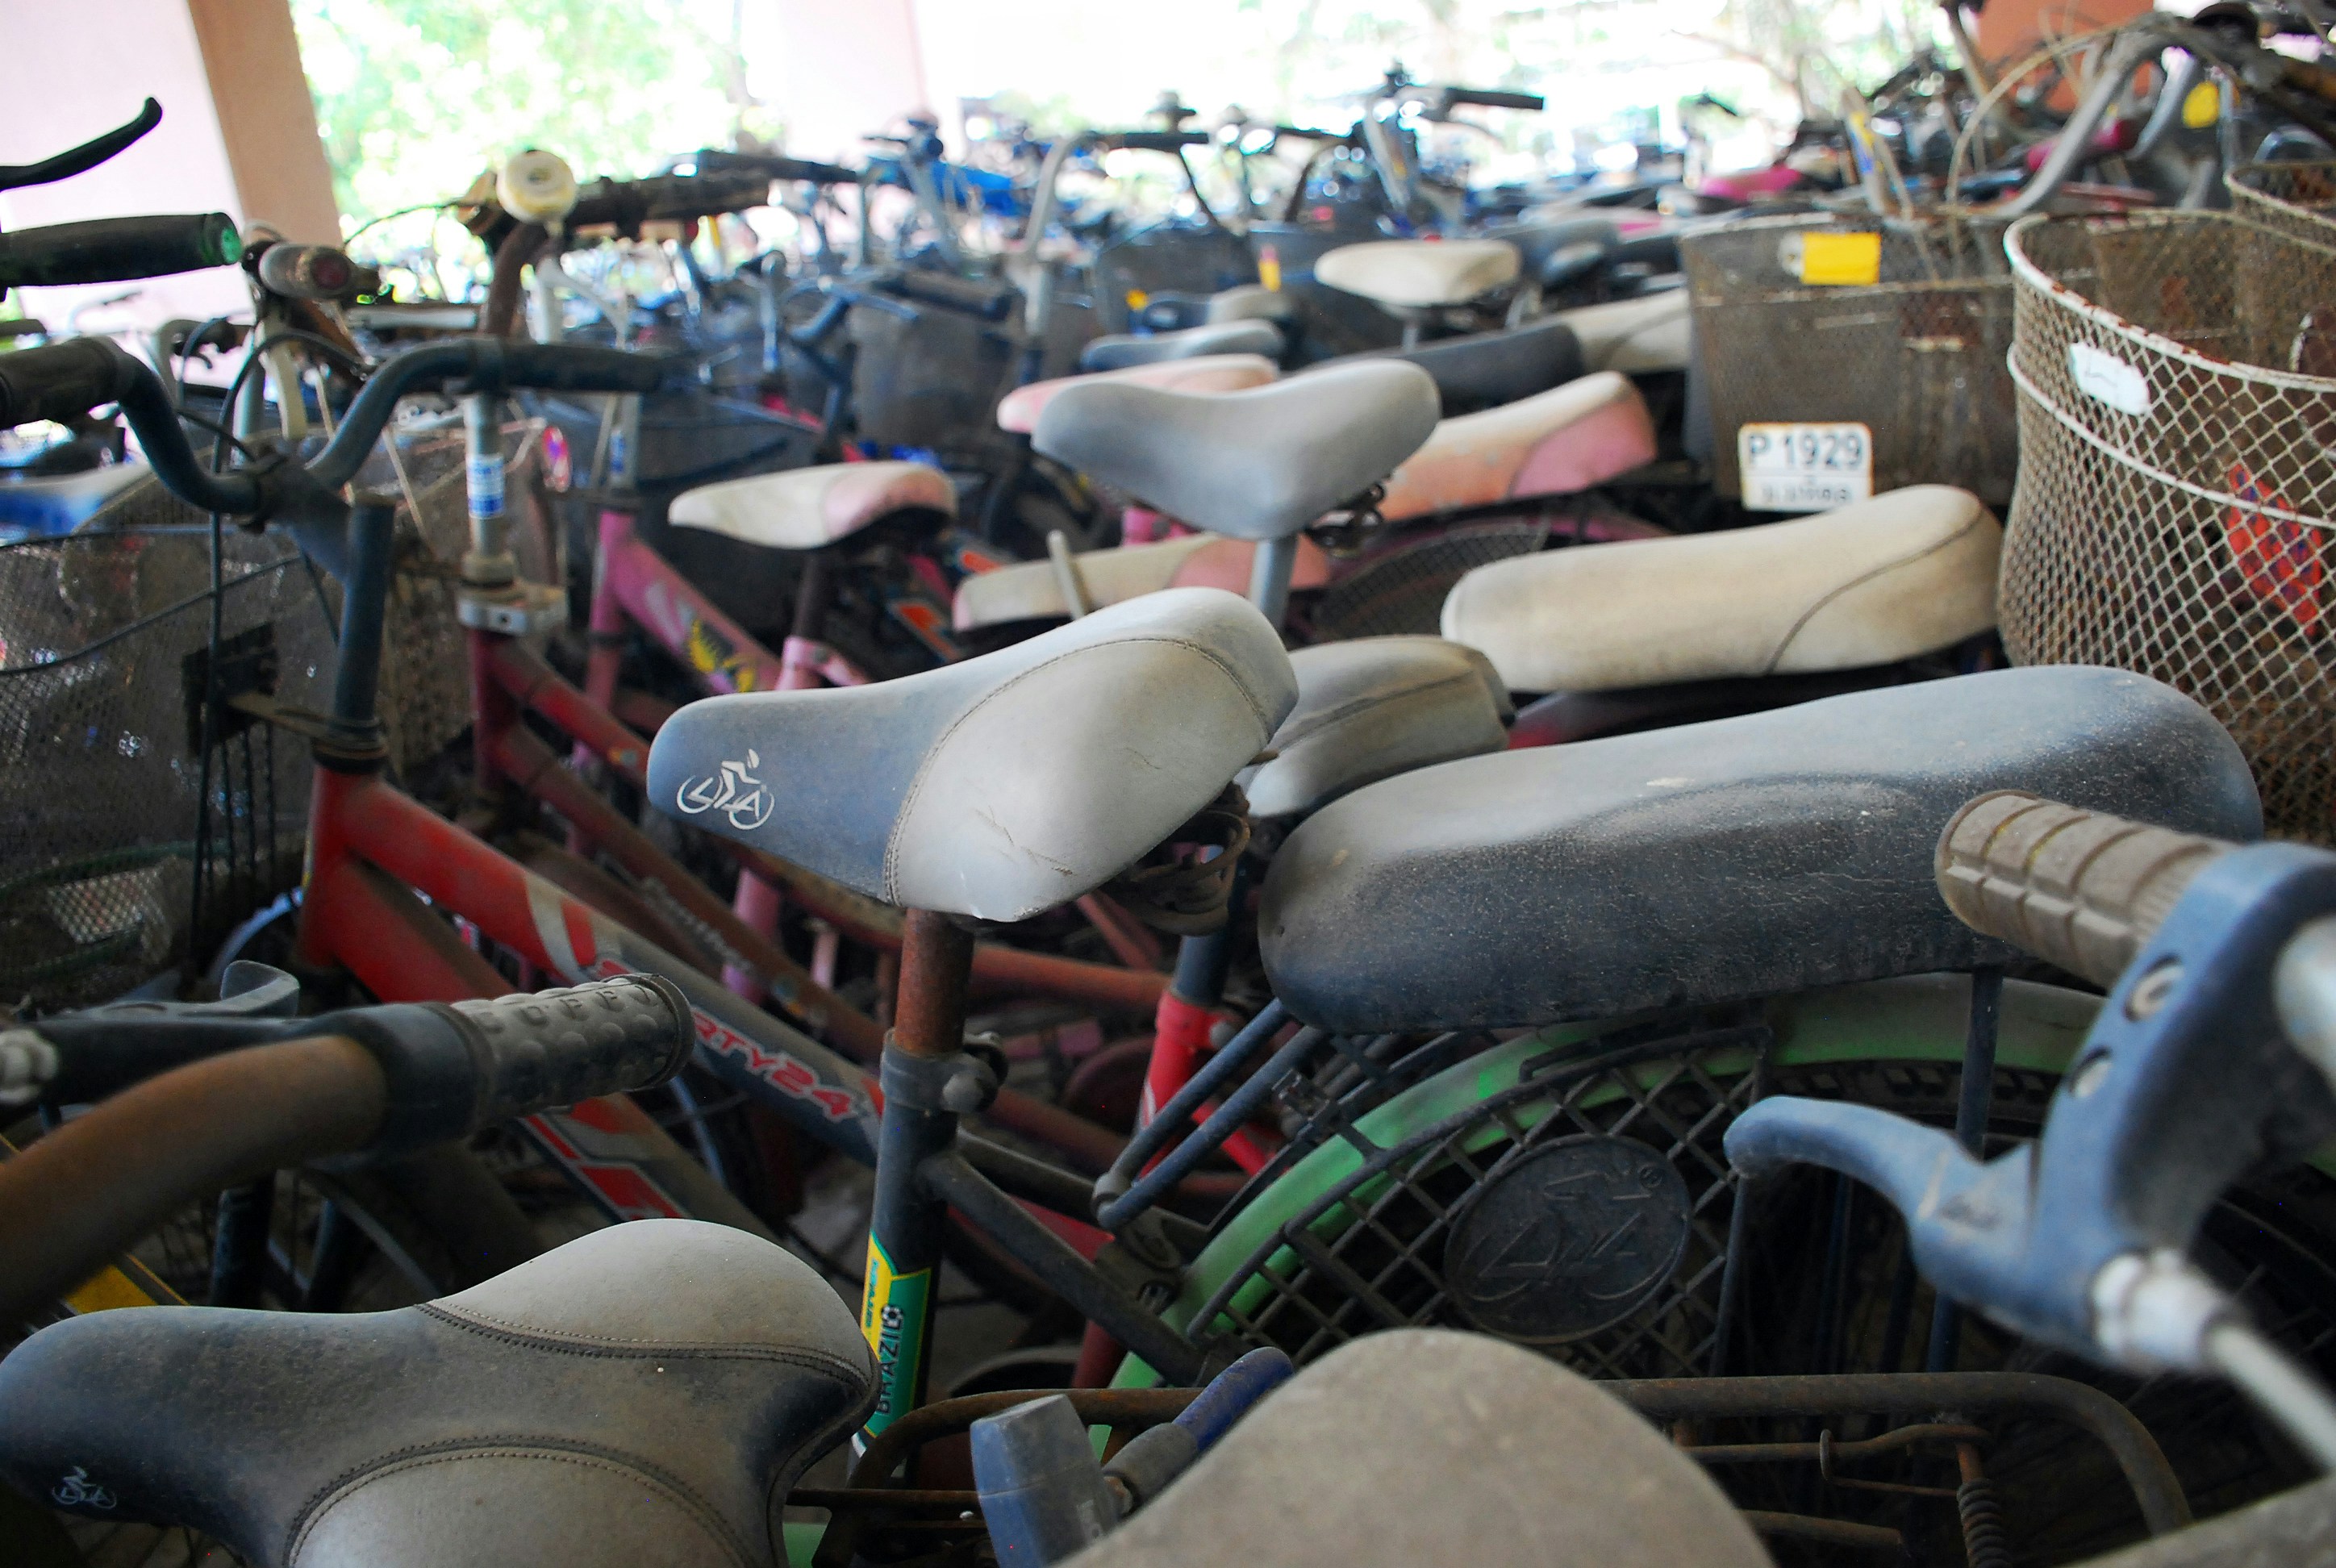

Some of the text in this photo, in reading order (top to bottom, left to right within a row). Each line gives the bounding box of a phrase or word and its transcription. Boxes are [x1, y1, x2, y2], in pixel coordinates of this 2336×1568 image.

[1749, 432, 1863, 469] P 1929
[692, 1007, 853, 1117] RTY24
